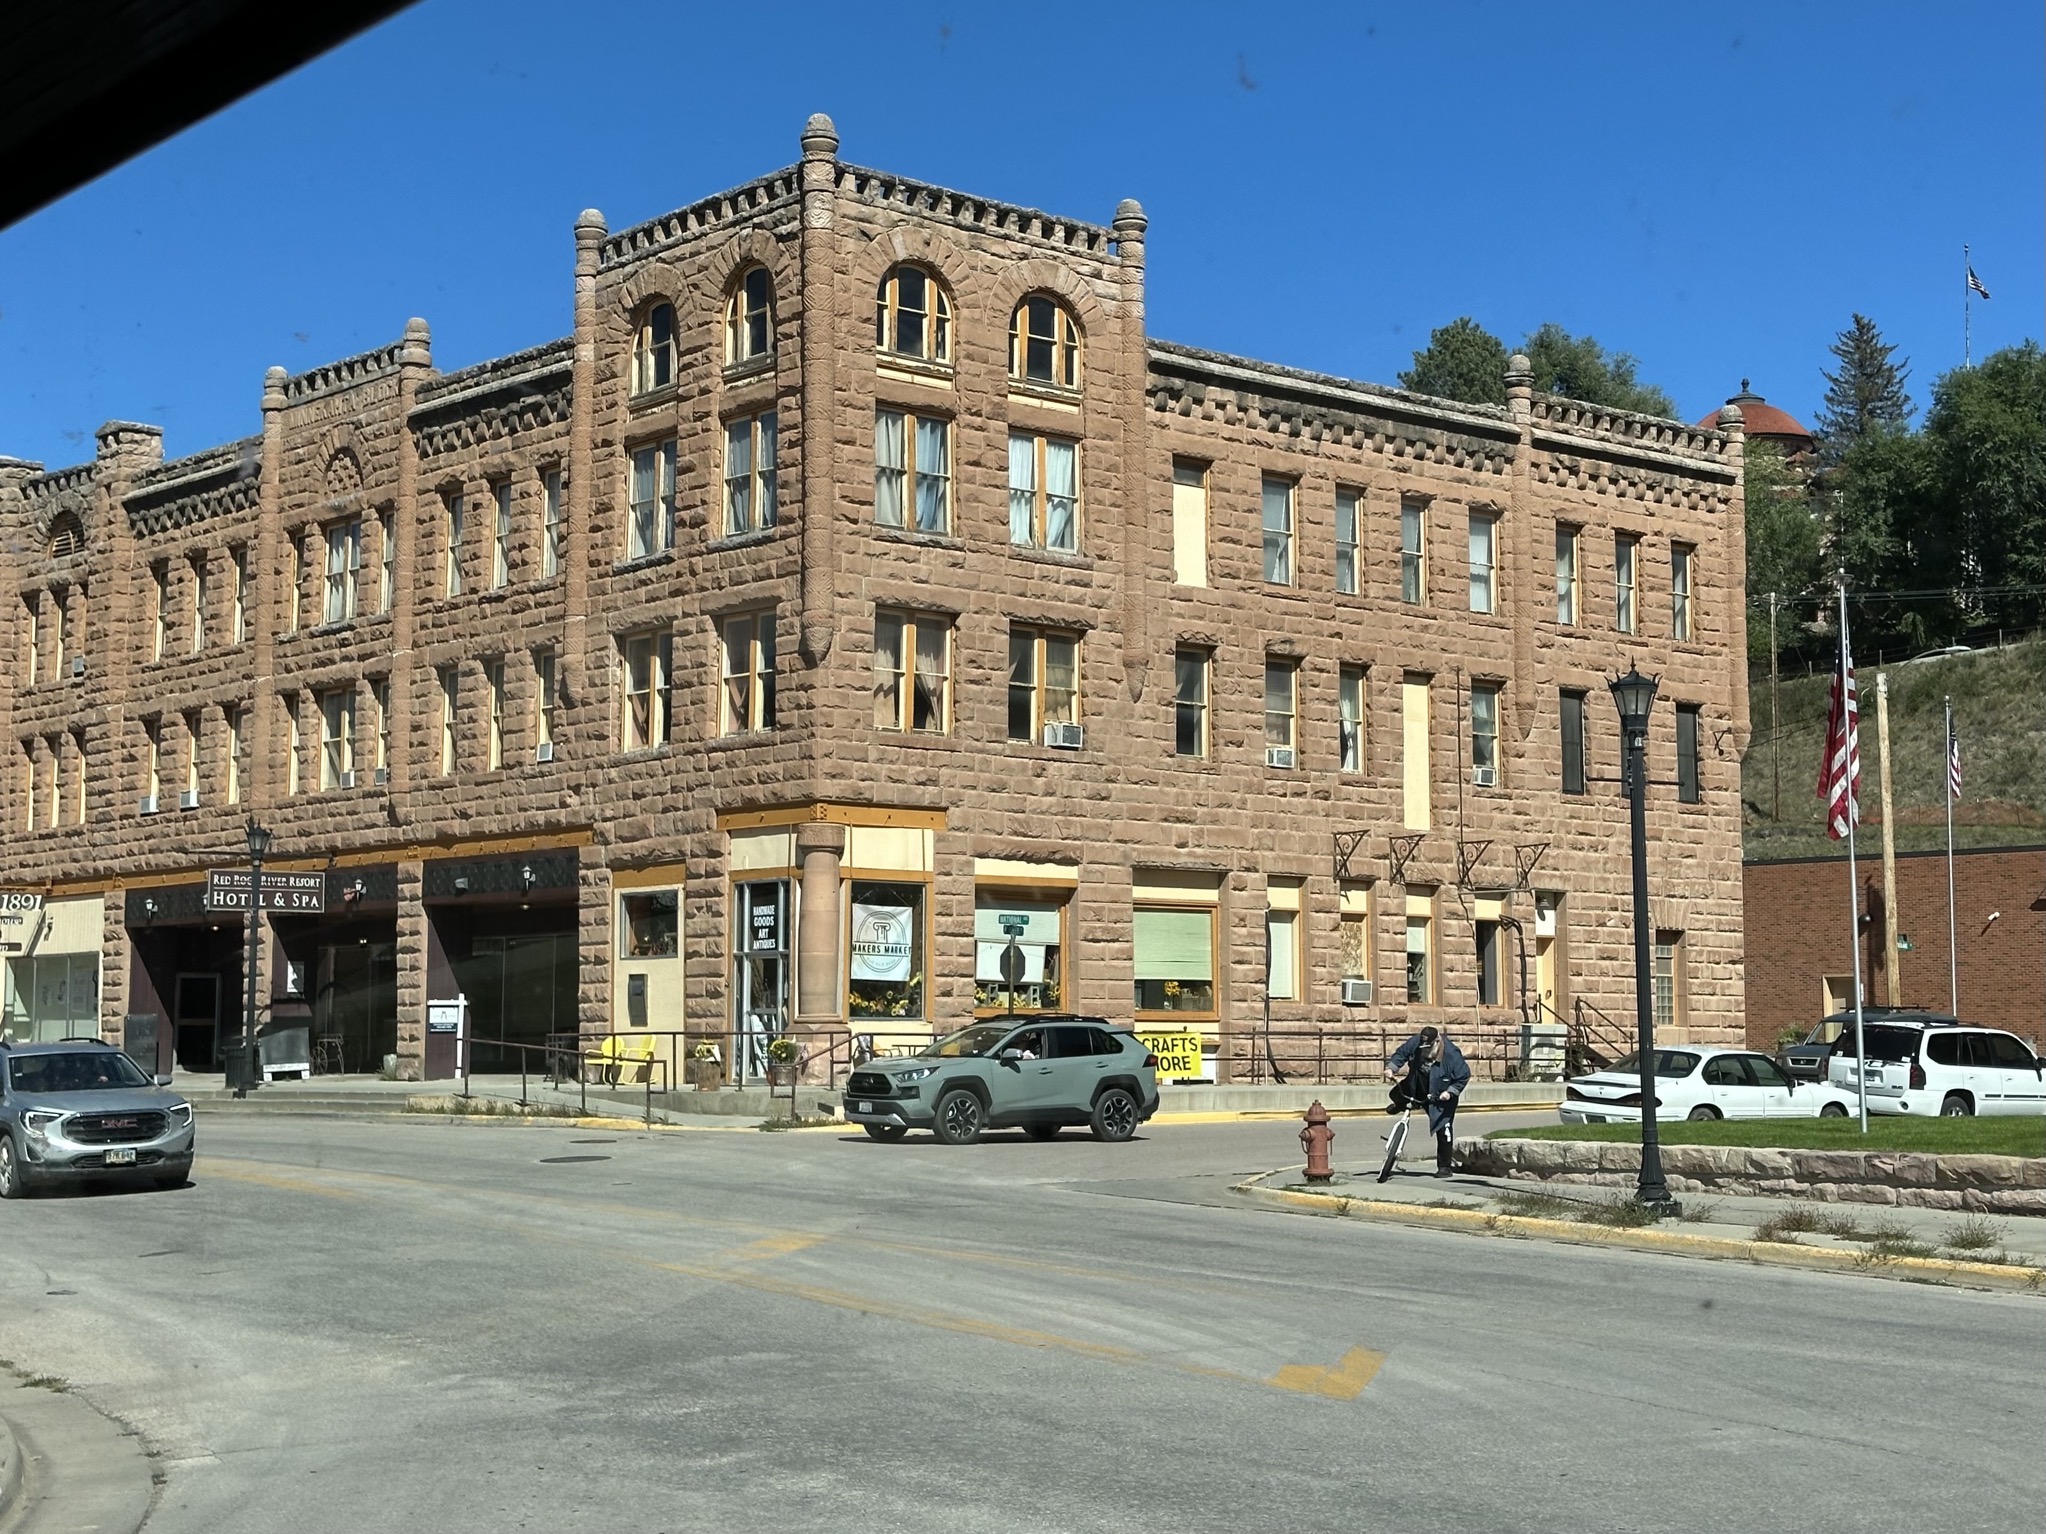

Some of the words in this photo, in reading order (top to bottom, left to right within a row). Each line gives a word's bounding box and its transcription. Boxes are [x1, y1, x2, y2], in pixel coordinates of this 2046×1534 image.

[362, 380, 399, 405] BLOCK
[213, 874, 232, 885] RED
[233, 875, 258, 886] ROC
[261, 876, 287, 887] RIVER
[289, 877, 320, 888] RESORT
[1, 894, 42, 911] 1891
[213, 892, 266, 906] HOTL
[274, 893, 285, 907] &
[292, 893, 319, 908] SPA
[753, 905, 775, 915] HANDMADE
[754, 916, 774, 926] GOODS
[758, 928, 769, 939] ART
[753, 939, 775, 950] ANTIQUES
[852, 944, 880, 953] MAKERS
[884, 946, 912, 955] MARKET
[1142, 1037, 1198, 1053] CRAFTS
